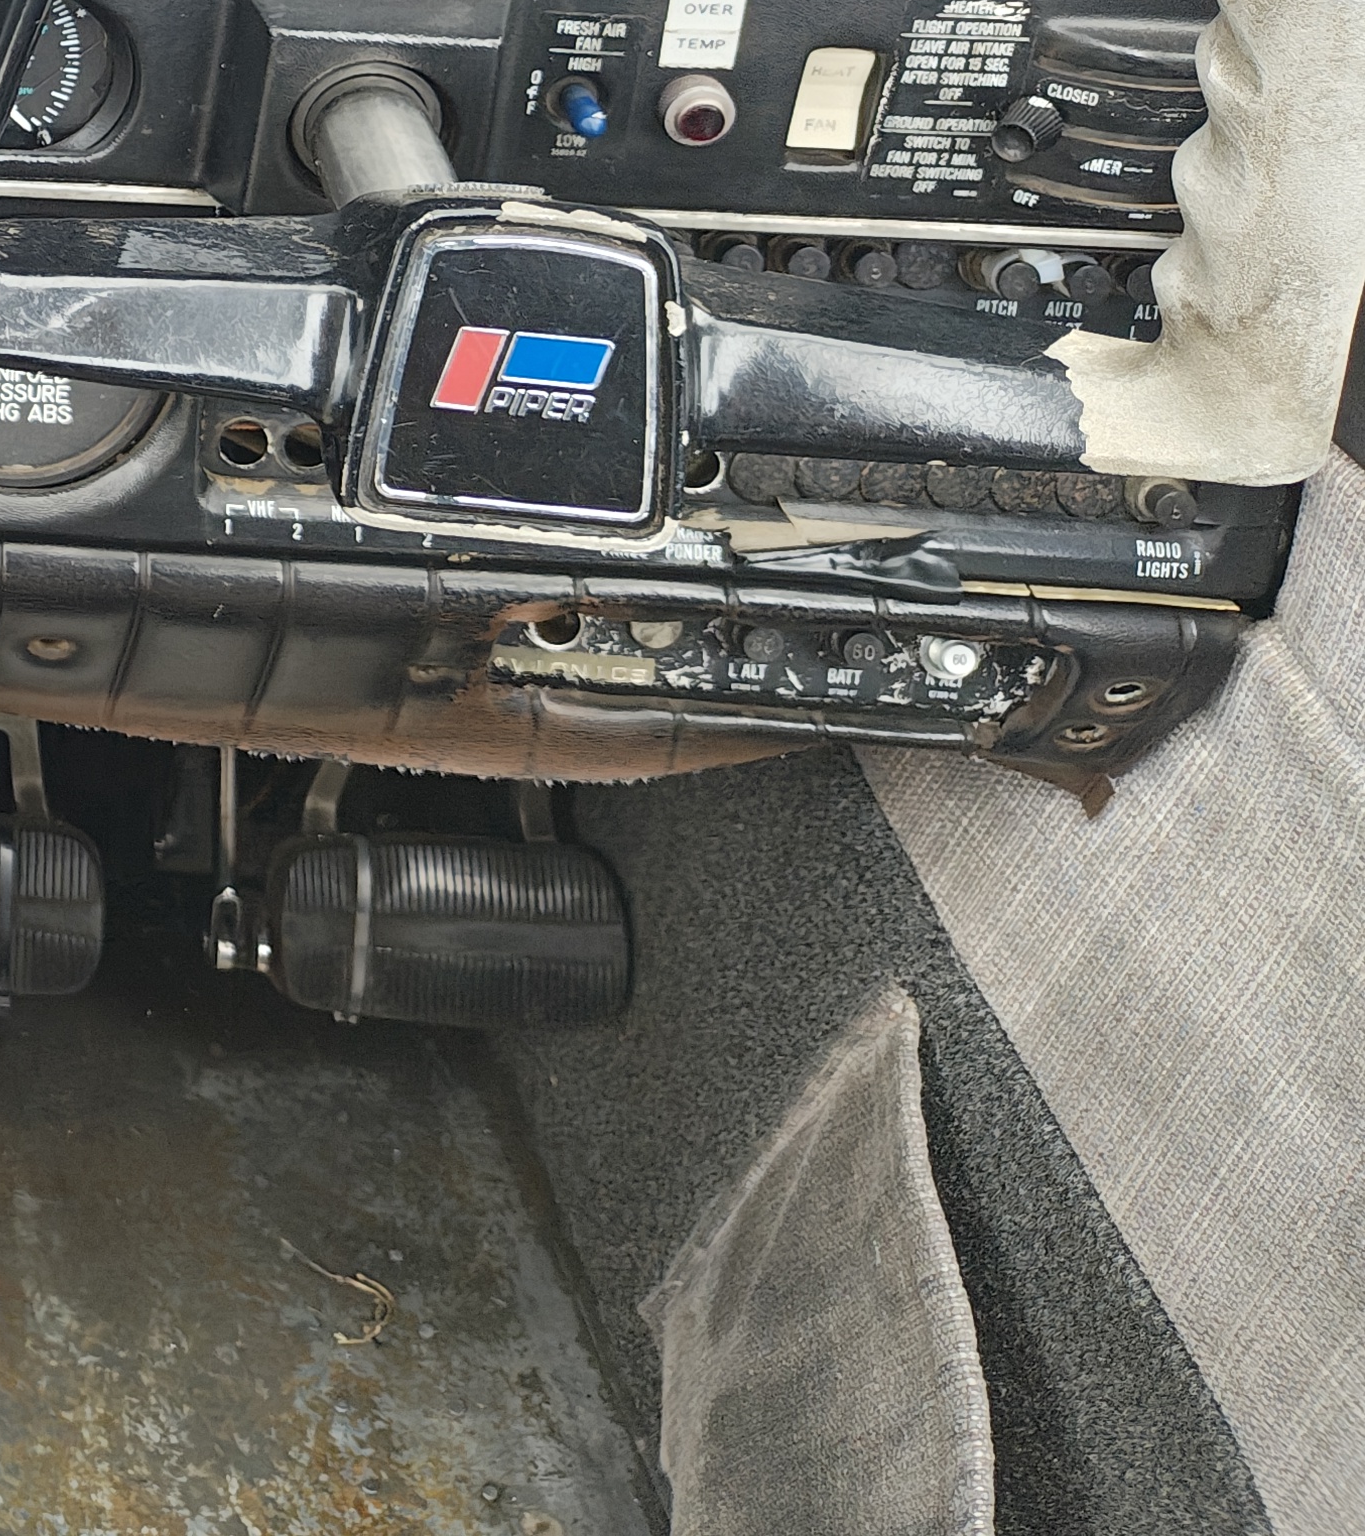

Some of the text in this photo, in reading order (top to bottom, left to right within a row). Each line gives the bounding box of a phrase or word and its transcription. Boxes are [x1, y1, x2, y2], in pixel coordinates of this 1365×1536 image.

[684, 2, 733, 16] OVER
[677, 37, 726, 50] TEMP
[1047, 83, 1100, 107] CLOSED
[27, 403, 73, 425] ABS
[486, 385, 595, 423] PIPER
[1135, 539, 1182, 560] RADIO
[1136, 560, 1189, 579] LIGHTS
